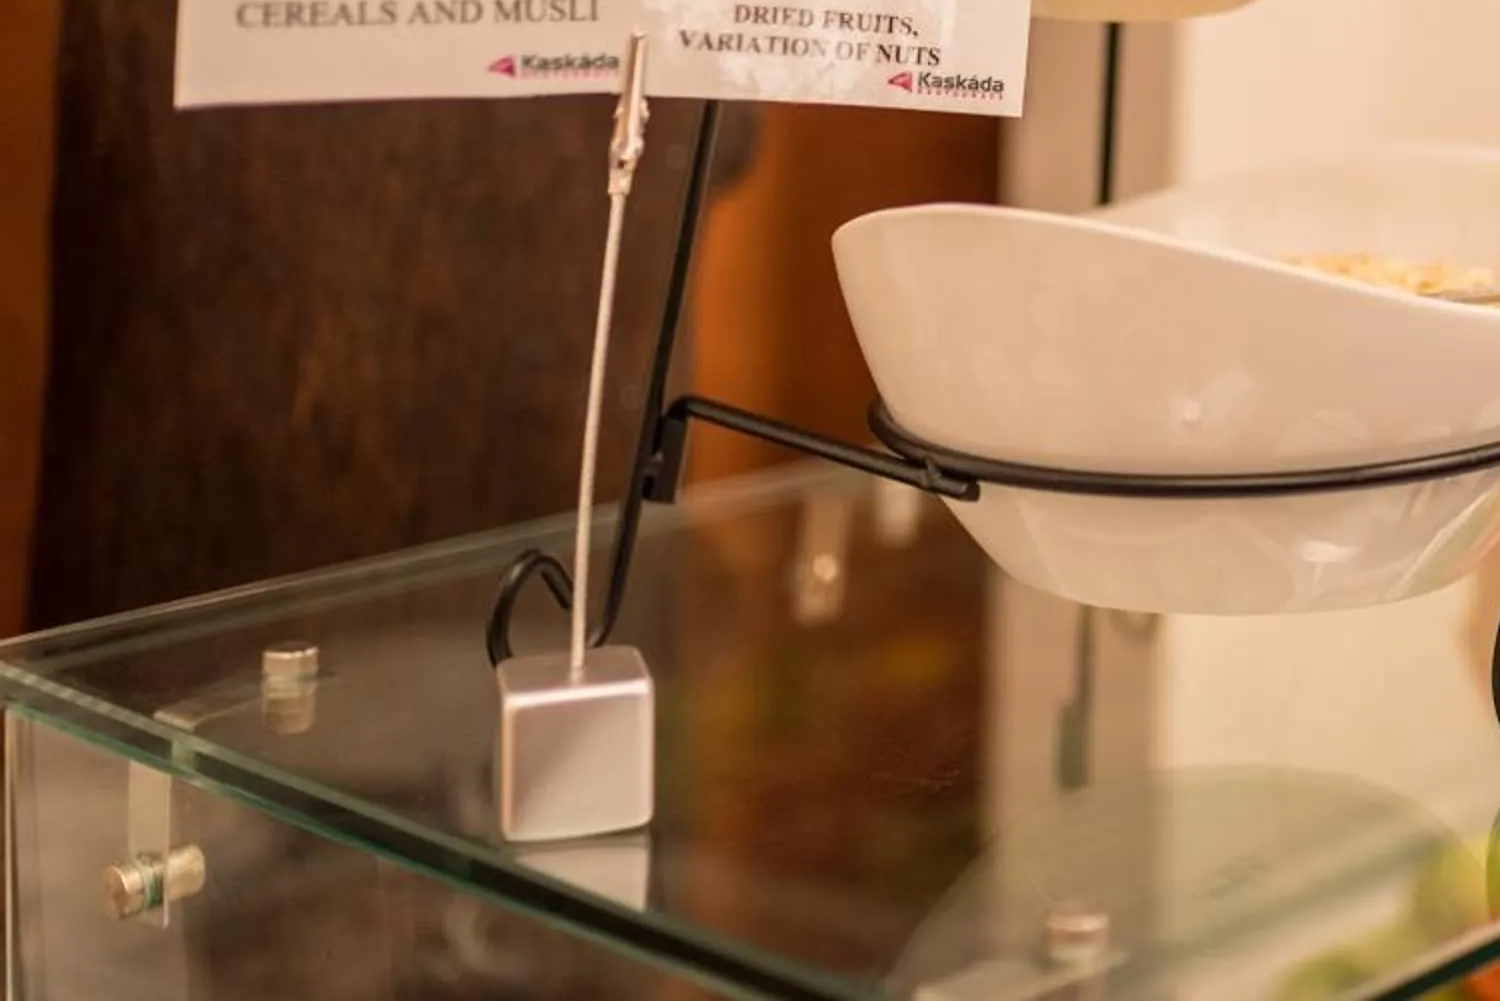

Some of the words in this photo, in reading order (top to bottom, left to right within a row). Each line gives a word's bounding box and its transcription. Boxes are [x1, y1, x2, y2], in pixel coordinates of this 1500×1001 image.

[235, 0, 398, 28] CEREALS
[407, 0, 484, 24] AND
[733, 4, 814, 28] DRIED
[678, 29, 827, 58] VARIATION
[836, 42, 870, 61] OF
[876, 44, 941, 66] NUTS
[520, 53, 620, 70] Kaskáda
[917, 71, 1005, 92] Kaskáda
